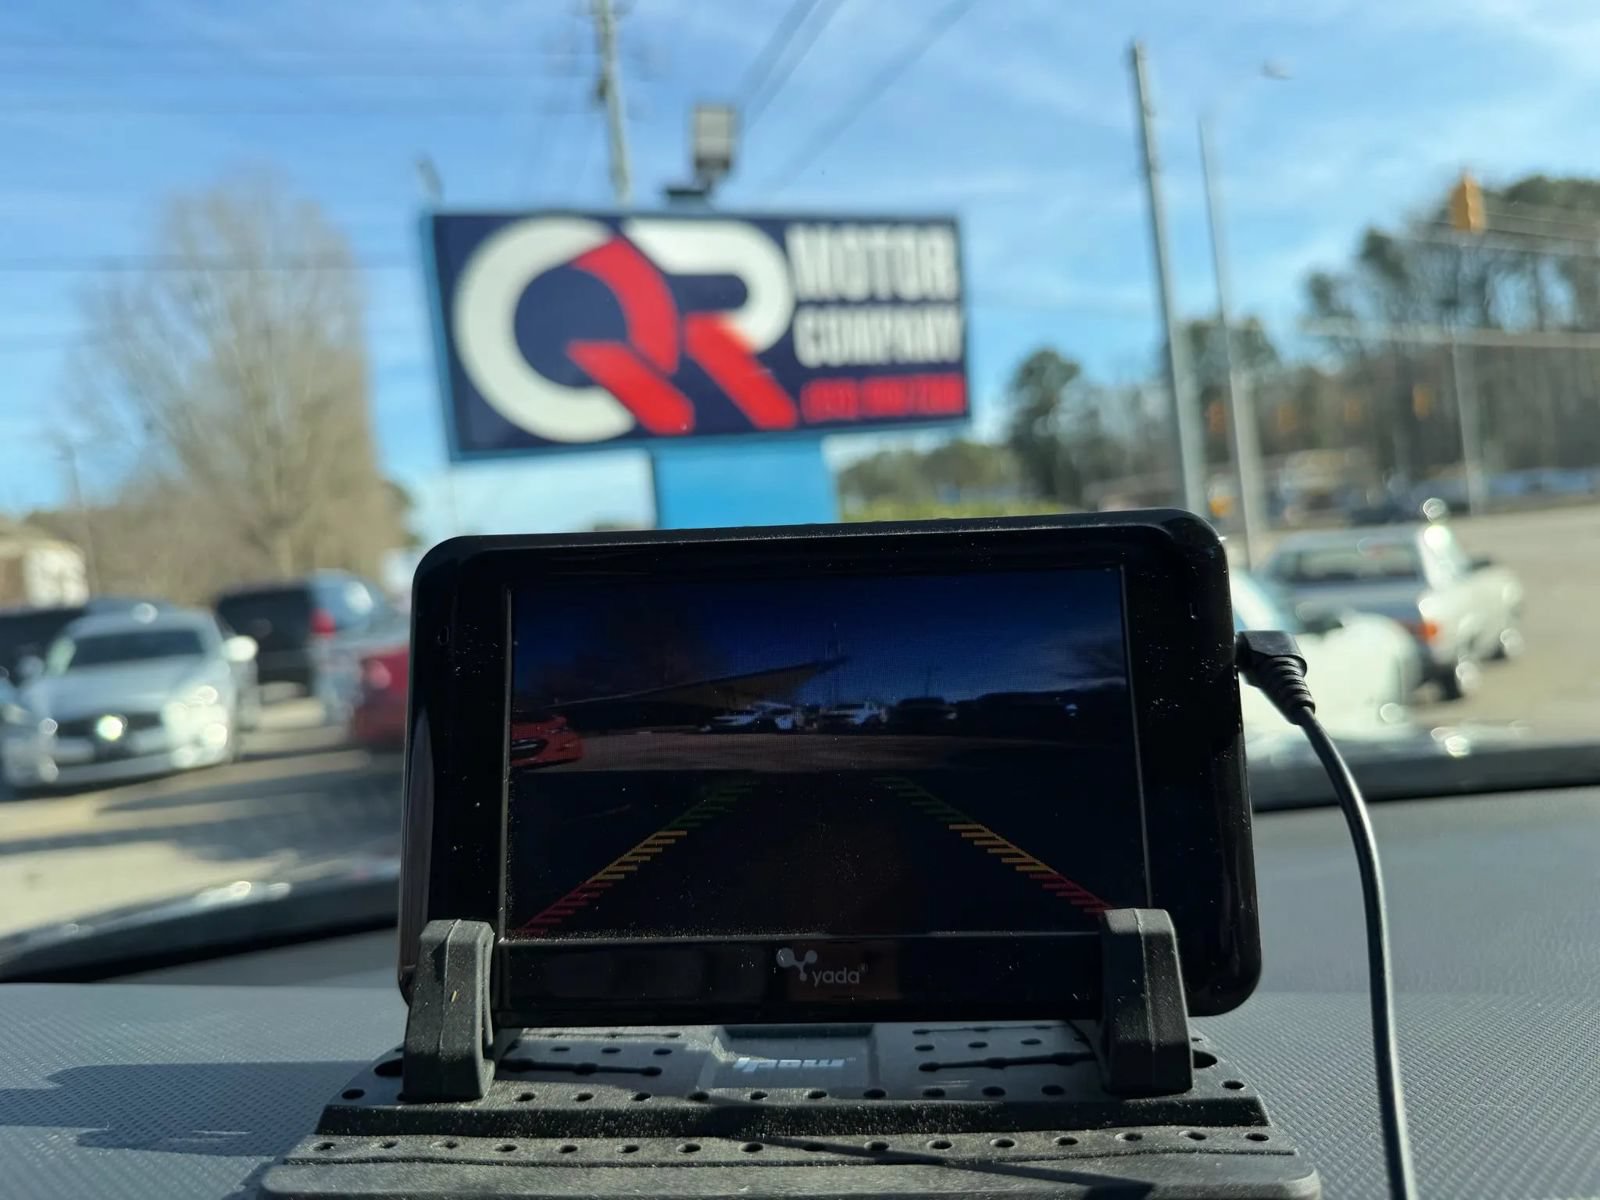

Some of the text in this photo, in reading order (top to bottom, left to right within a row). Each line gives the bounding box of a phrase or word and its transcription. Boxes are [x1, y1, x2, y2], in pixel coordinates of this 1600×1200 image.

[786, 224, 958, 299] MOTOR
[453, 217, 797, 442] QR
[793, 306, 963, 368] COMPANY
[812, 966, 860, 988] yada
